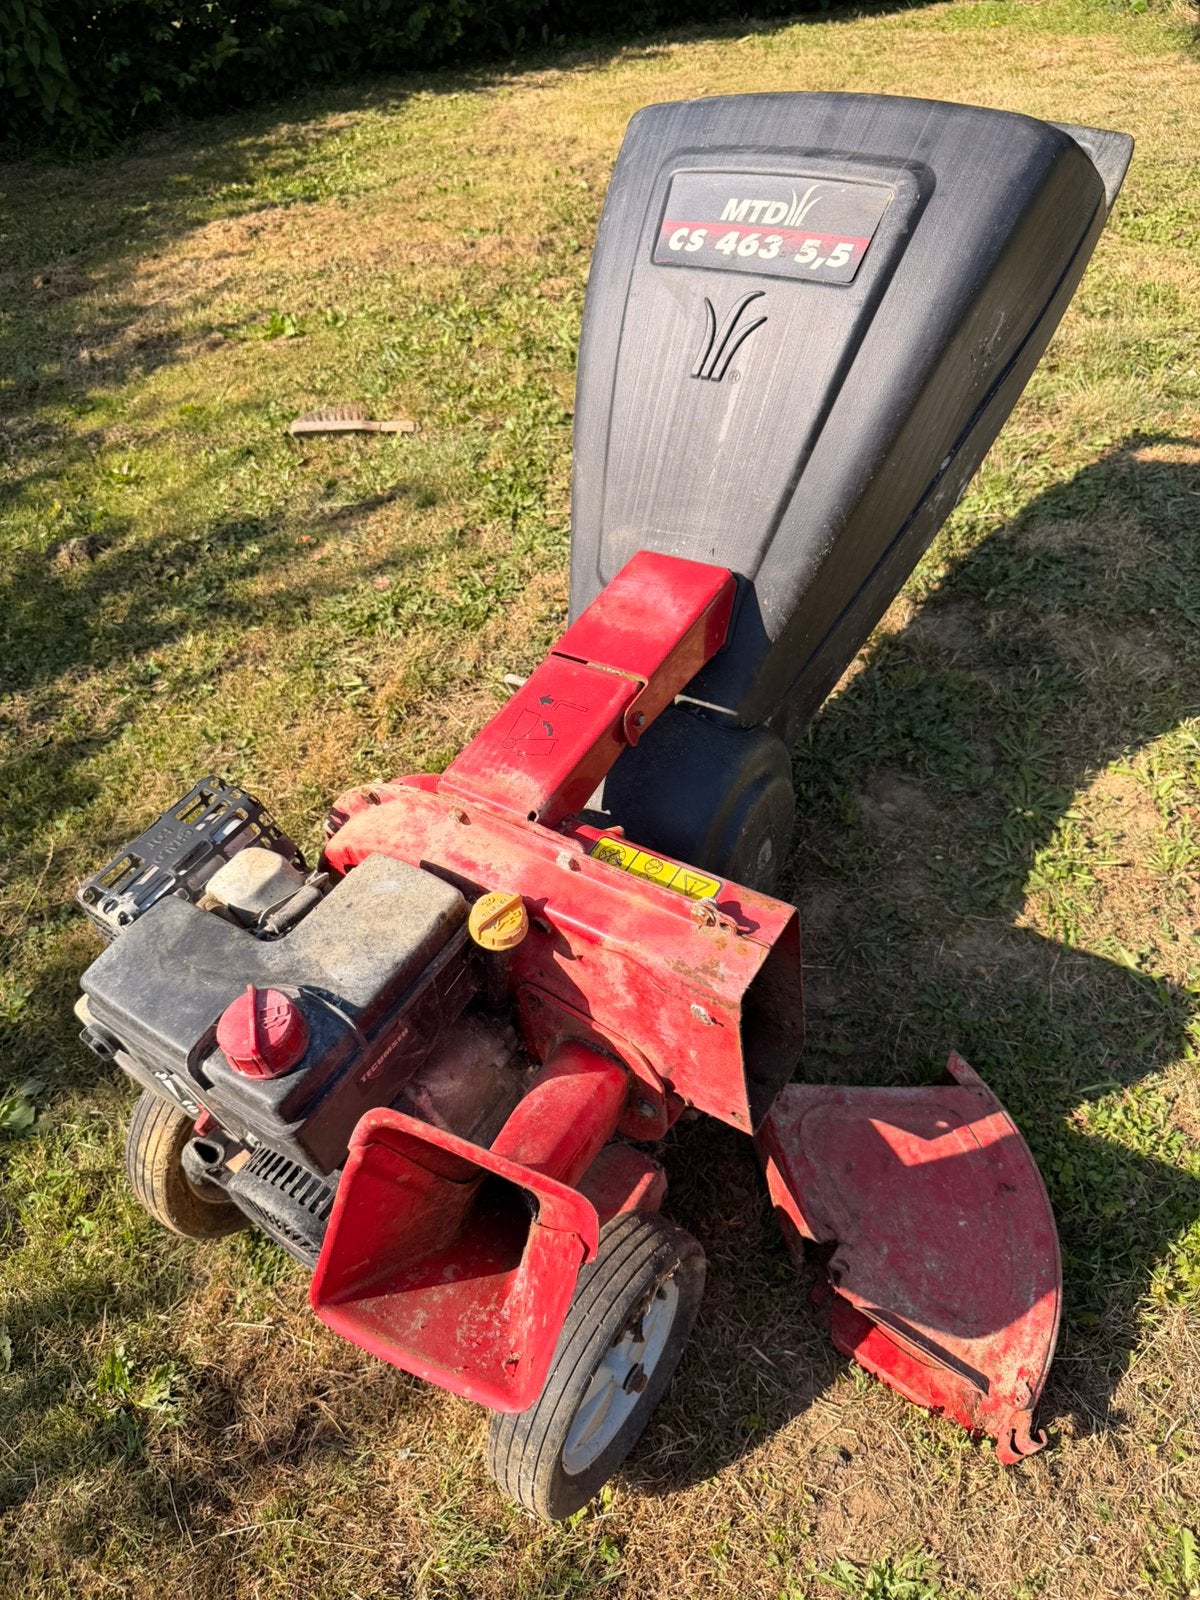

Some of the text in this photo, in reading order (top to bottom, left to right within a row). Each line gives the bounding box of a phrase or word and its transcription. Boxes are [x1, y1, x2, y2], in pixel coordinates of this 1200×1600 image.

[720, 199, 788, 226] MTD
[668, 227, 855, 270] CS 463 5,5
[361, 1027, 409, 1082] TECUMSEH
